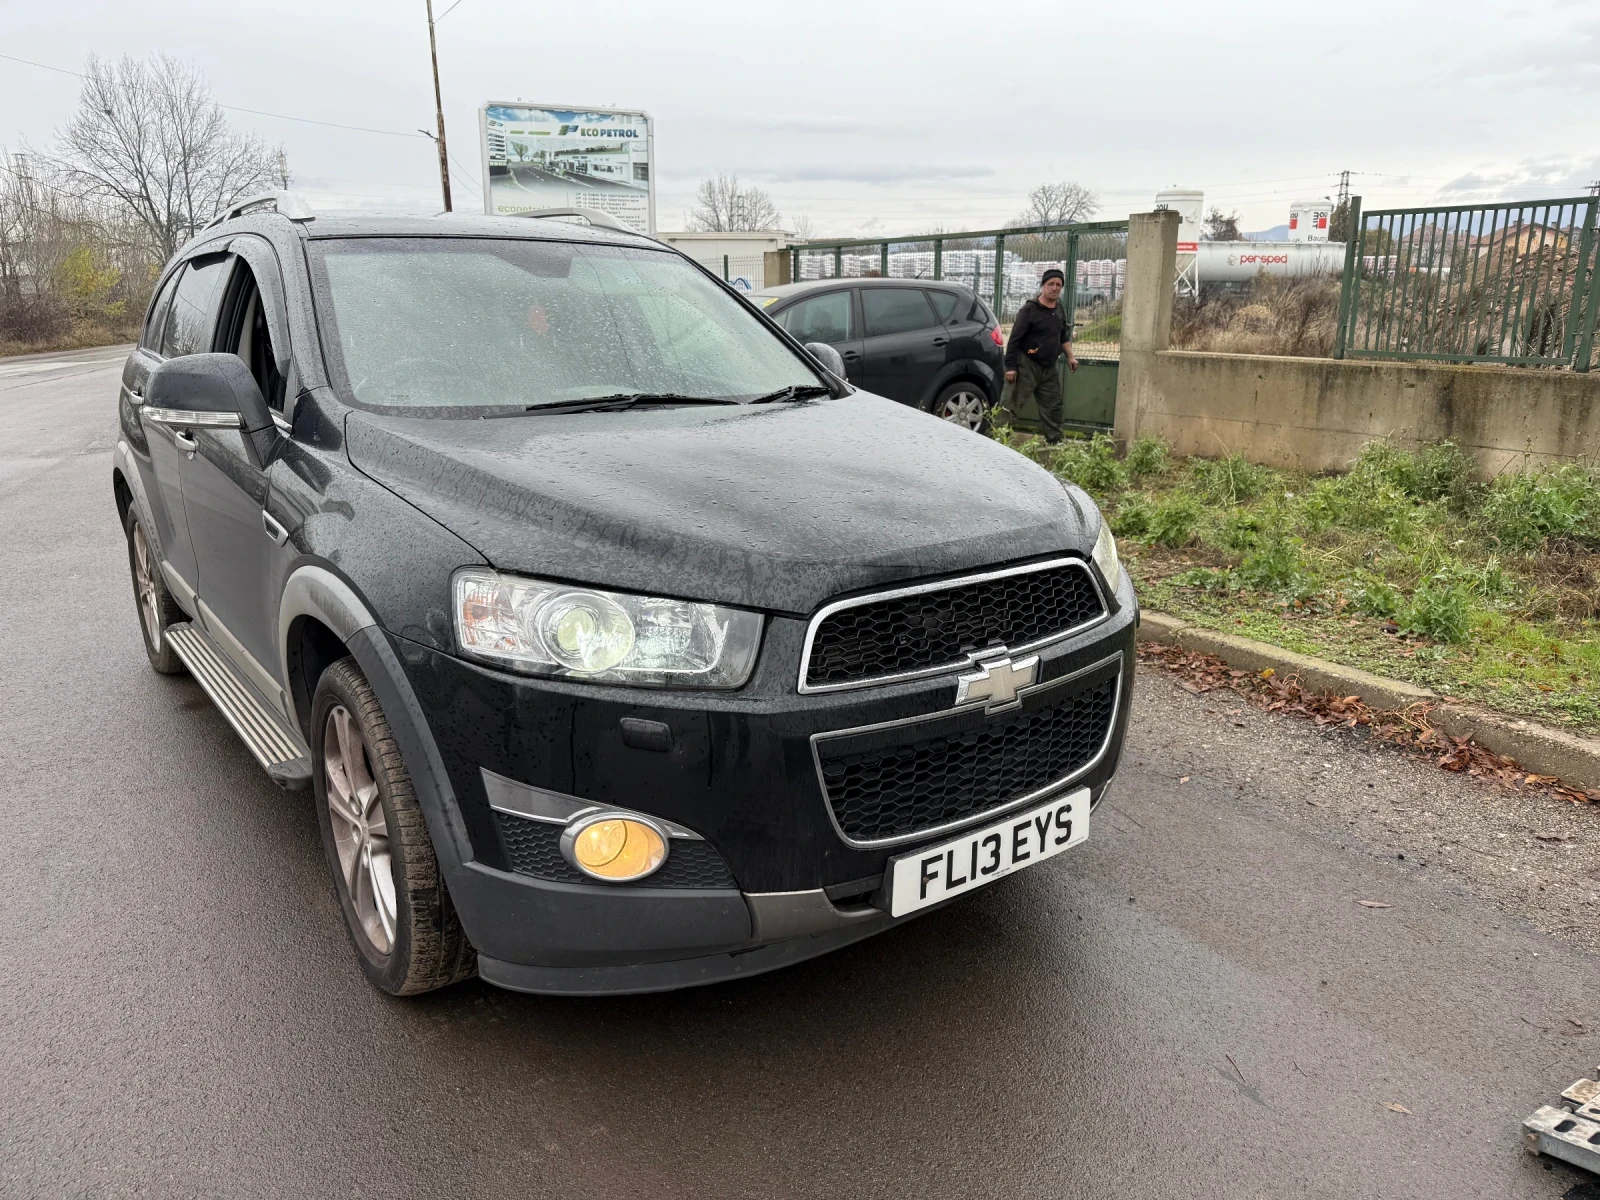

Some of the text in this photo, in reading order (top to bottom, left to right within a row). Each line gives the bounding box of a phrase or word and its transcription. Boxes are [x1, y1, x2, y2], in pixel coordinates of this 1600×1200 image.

[1240, 253, 1288, 265] persped
[920, 804, 1072, 900] FL13 EYS
